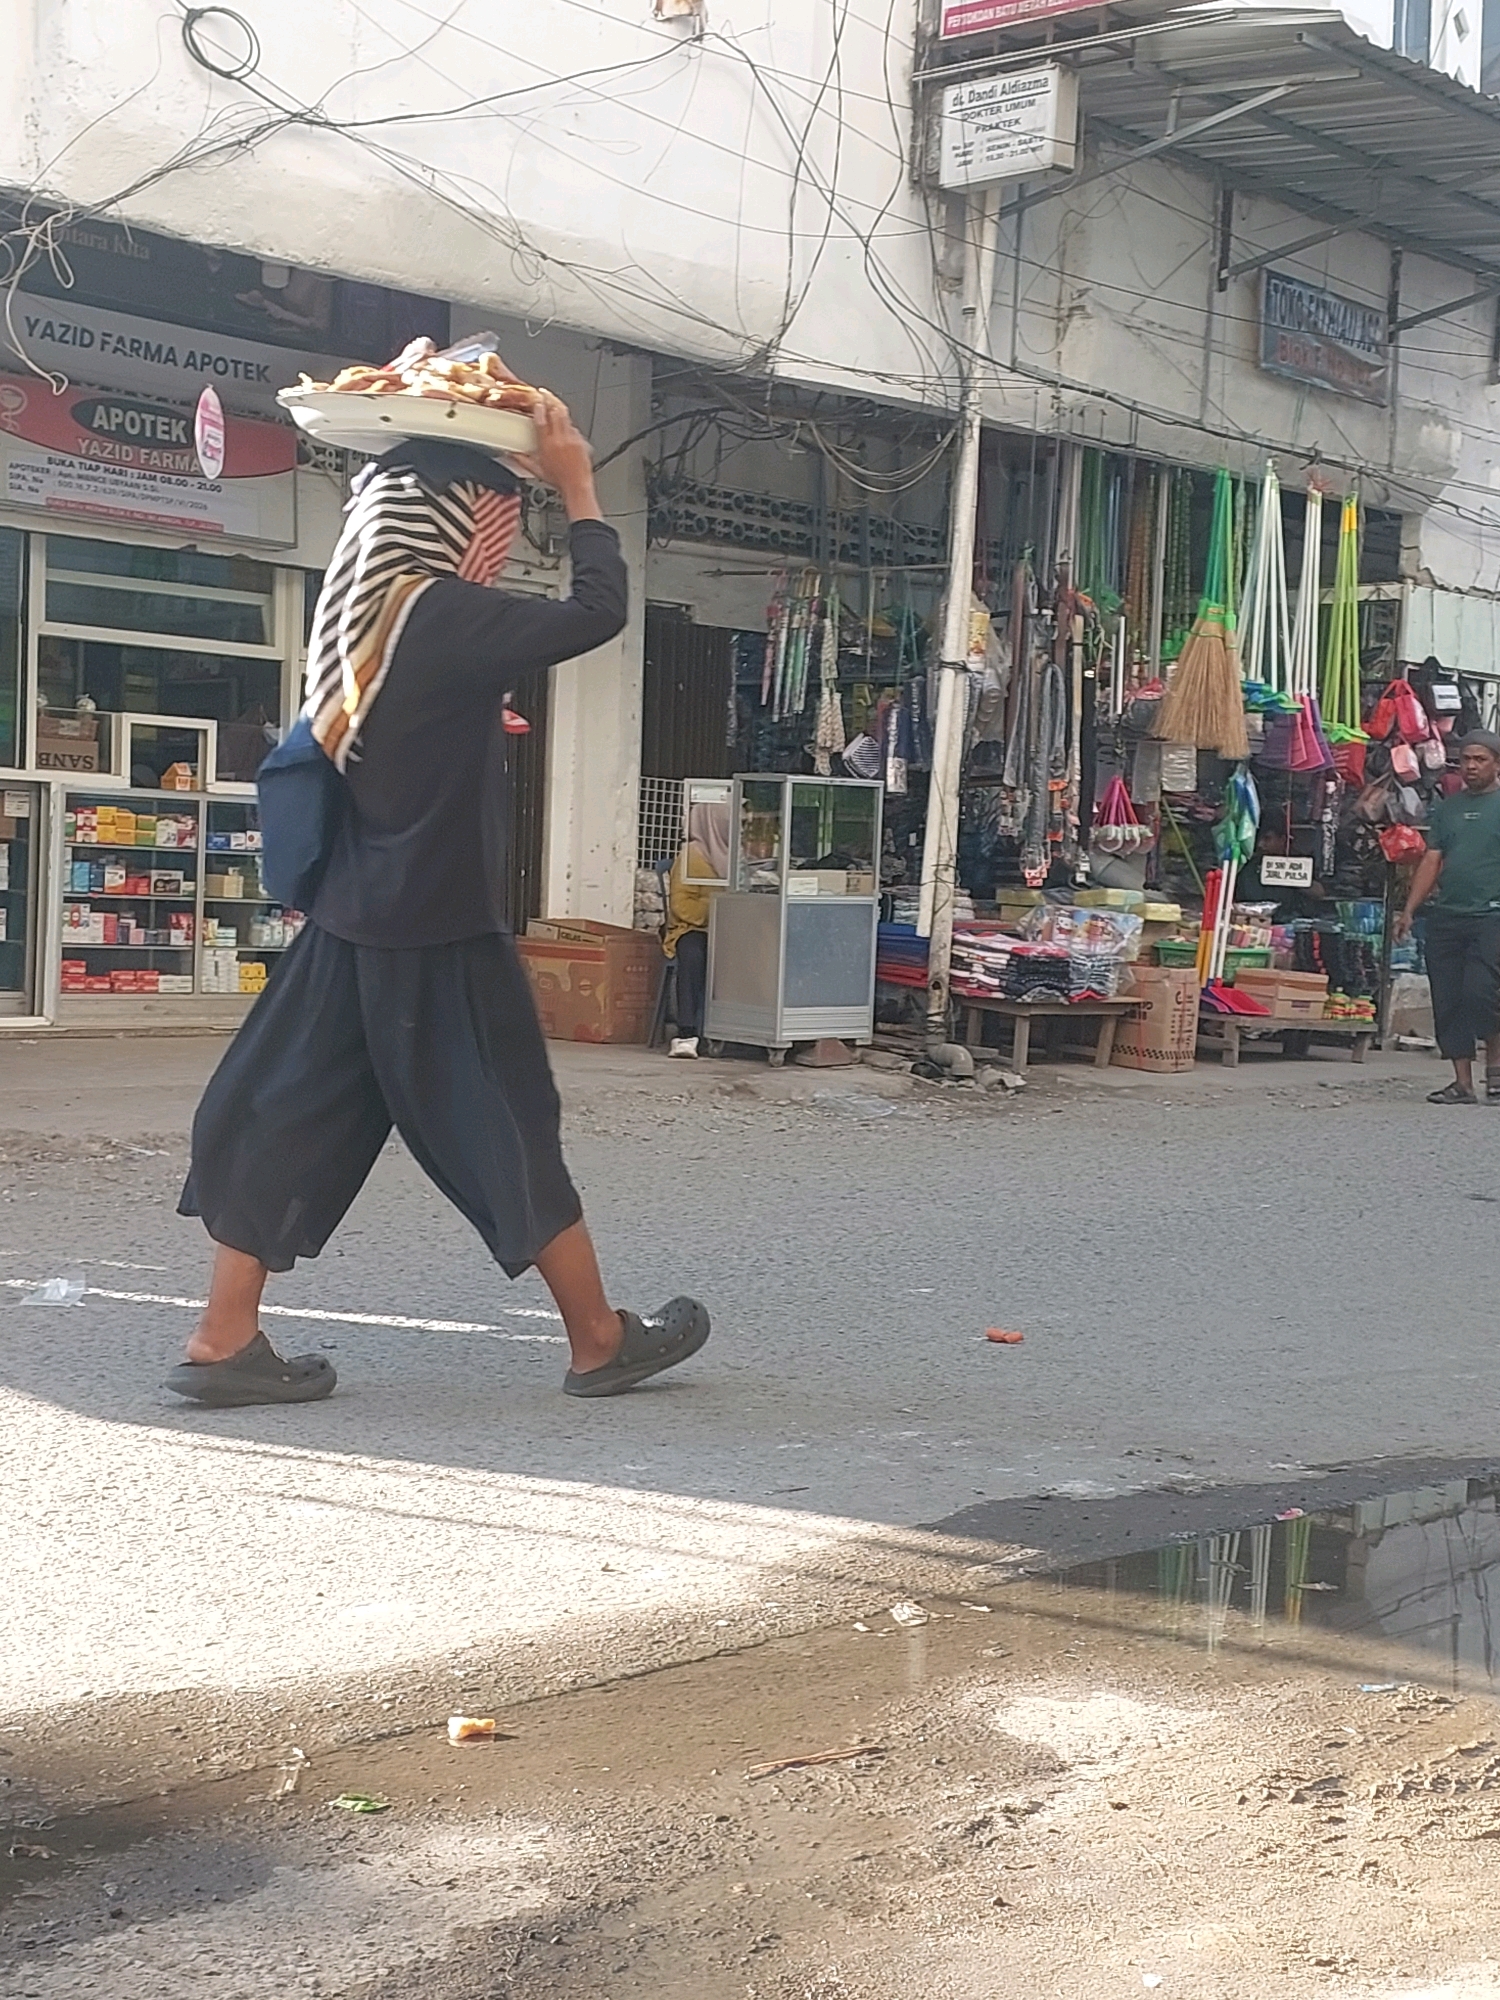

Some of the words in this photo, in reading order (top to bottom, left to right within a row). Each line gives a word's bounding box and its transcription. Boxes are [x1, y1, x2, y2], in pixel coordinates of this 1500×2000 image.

[968, 84, 998, 104] Dandi
[999, 77, 1050, 97] Aldiazma
[961, 105, 1003, 121] DOKTER
[1004, 98, 1037, 113] UMUM
[974, 117, 1022, 134] PRAKTEK
[24, 315, 95, 349] YAZID
[100, 331, 178, 368] FARMA
[182, 350, 272, 384] APOTEK
[92, 404, 188, 444] APOTEK
[77, 437, 133, 463] YAZID
[140, 448, 201, 473] FARMA
[47, 456, 75, 469] BUKA
[78, 461, 101, 472] TIAP
[103, 466, 128, 478] HARI
[136, 472, 158, 482] JAM
[160, 475, 188, 488] 08.00
[196, 481, 223, 493] 21.00
[1284, 871, 1308, 881] PULSA
